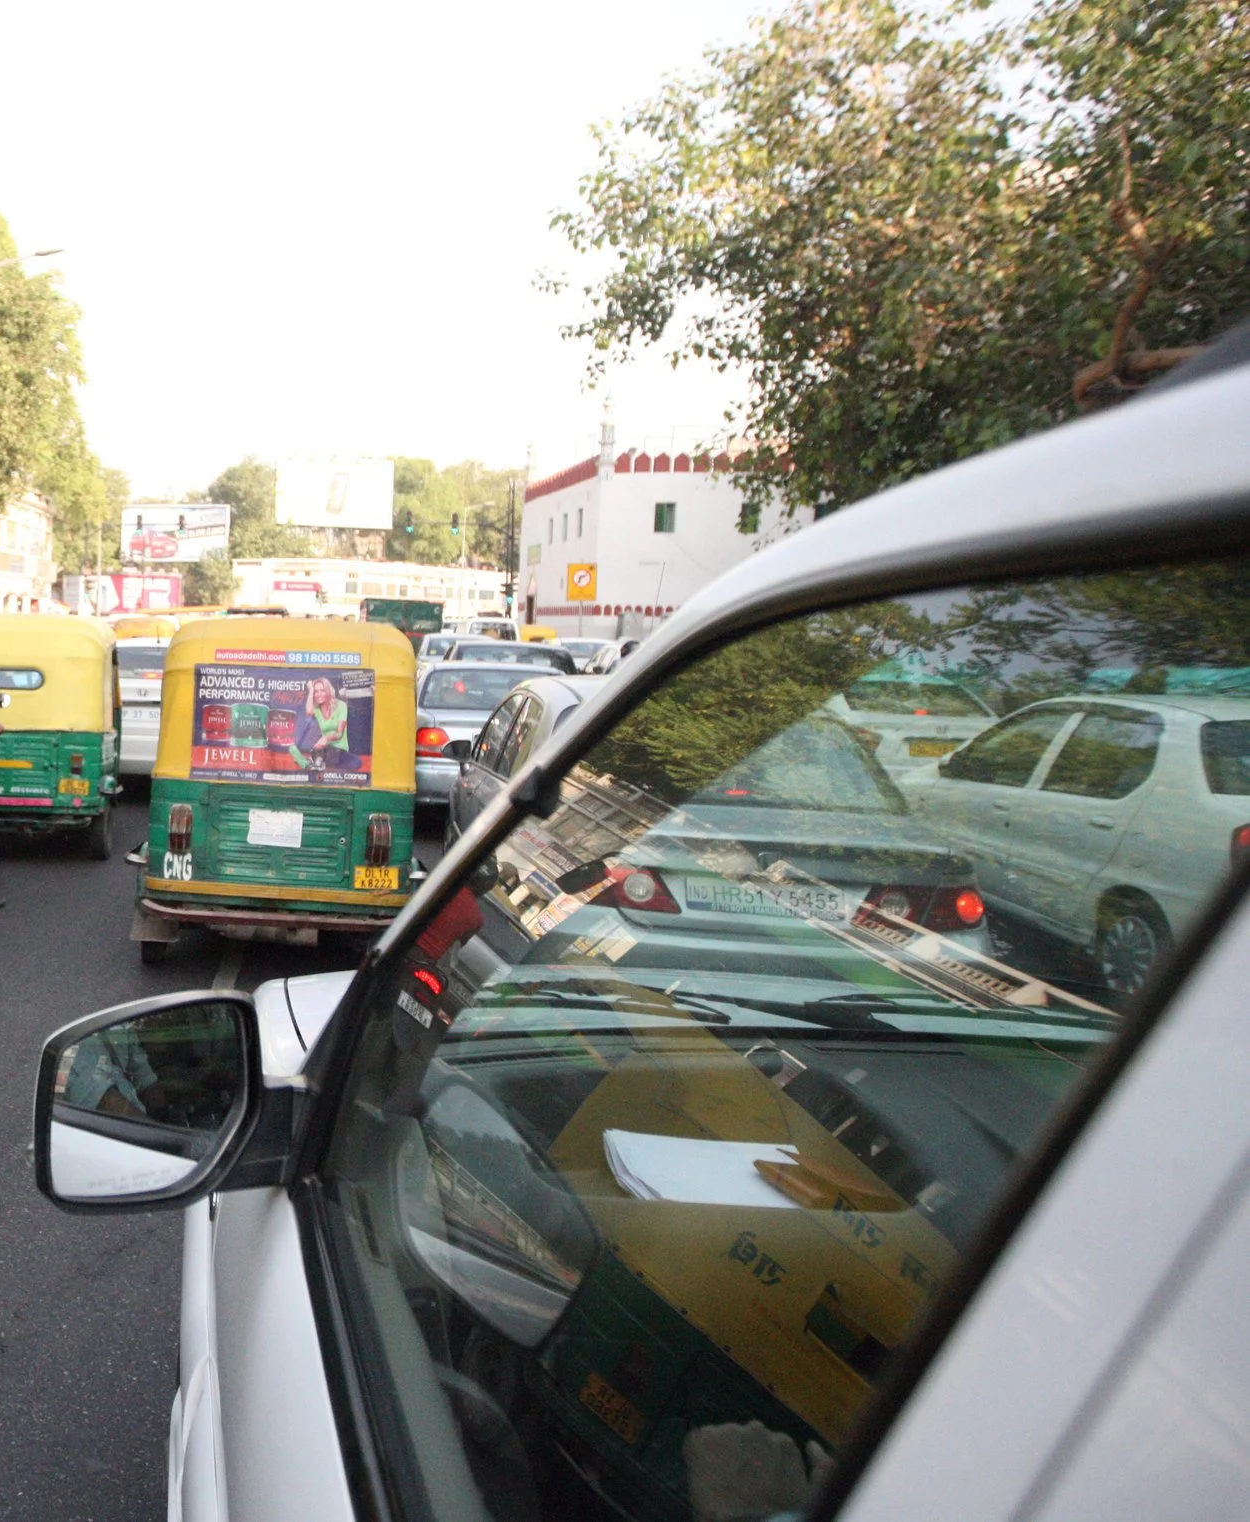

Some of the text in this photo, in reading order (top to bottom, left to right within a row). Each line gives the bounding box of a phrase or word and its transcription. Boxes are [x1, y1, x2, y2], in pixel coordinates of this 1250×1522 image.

[228, 668, 246, 676] MOST
[199, 676, 255, 689] ADVANCED
[268, 680, 307, 691] HIGHEST
[199, 689, 270, 701] PERFORMANCE
[204, 748, 257, 765] JEWELL
[163, 852, 193, 881] CNG
[361, 879, 393, 889] K8222
[688, 884, 708, 900] IND
